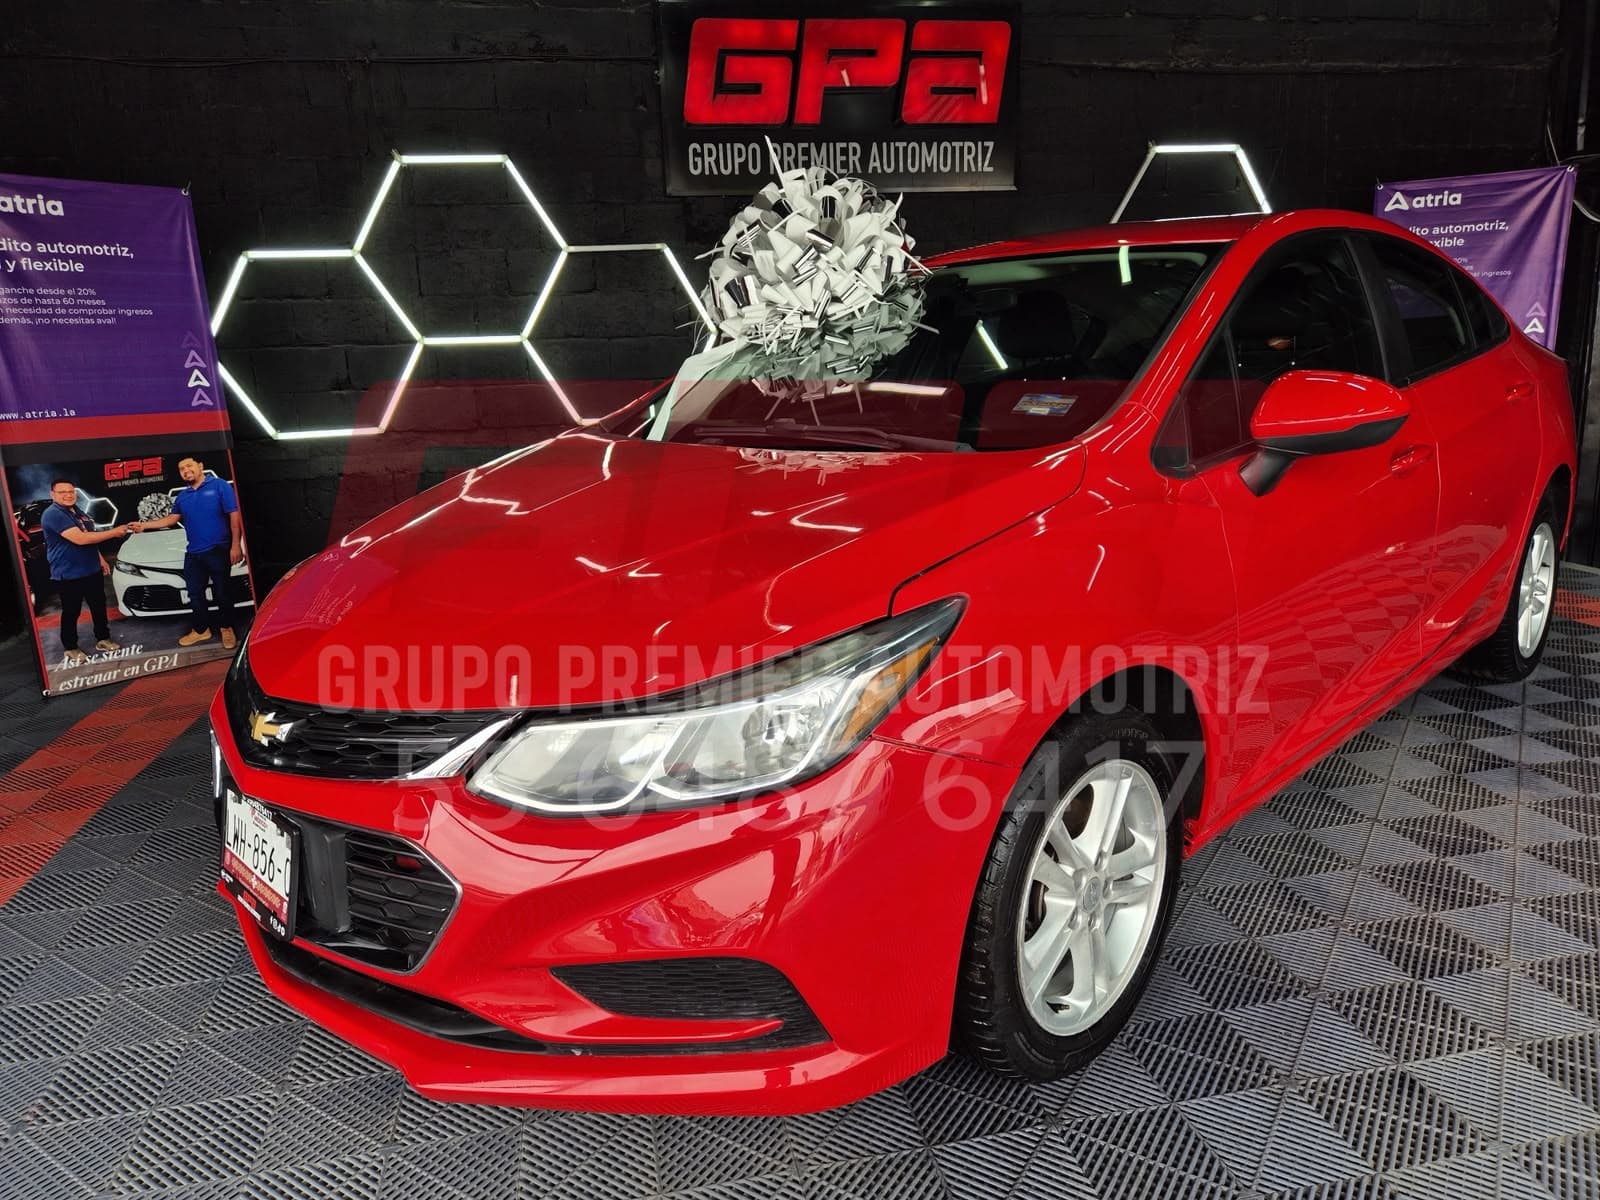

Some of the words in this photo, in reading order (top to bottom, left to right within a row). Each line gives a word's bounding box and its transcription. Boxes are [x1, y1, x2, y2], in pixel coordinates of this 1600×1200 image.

[688, 142, 762, 175] GRUPO
[769, 142, 862, 175] PREMIER
[868, 141, 995, 174] AUTOMOTRIZ
[0, 194, 64, 216] atria
[1412, 190, 1462, 209] atria
[1432, 220, 1509, 236] automotriz,
[36, 241, 134, 258] automotriz,
[1430, 237, 1465, 247] xible
[5, 259, 16, 272] y
[20, 257, 84, 272] flexible
[36, 287, 65, 296] desde
[67, 288, 75, 296] el
[77, 288, 97, 296] 20%
[20, 297, 32, 305] de
[35, 297, 61, 305] hasta
[6, 306, 53, 315] necesidad
[55, 307, 67, 315] de
[68, 307, 116, 317] comprobar
[118, 308, 153, 317] ingresos
[52, 317, 95, 325] necesitas
[84, 653, 99, 666] se
[101, 644, 143, 662] siente
[58, 669, 121, 691] estrenar
[123, 664, 140, 677] en
[143, 653, 179, 672] GPA
